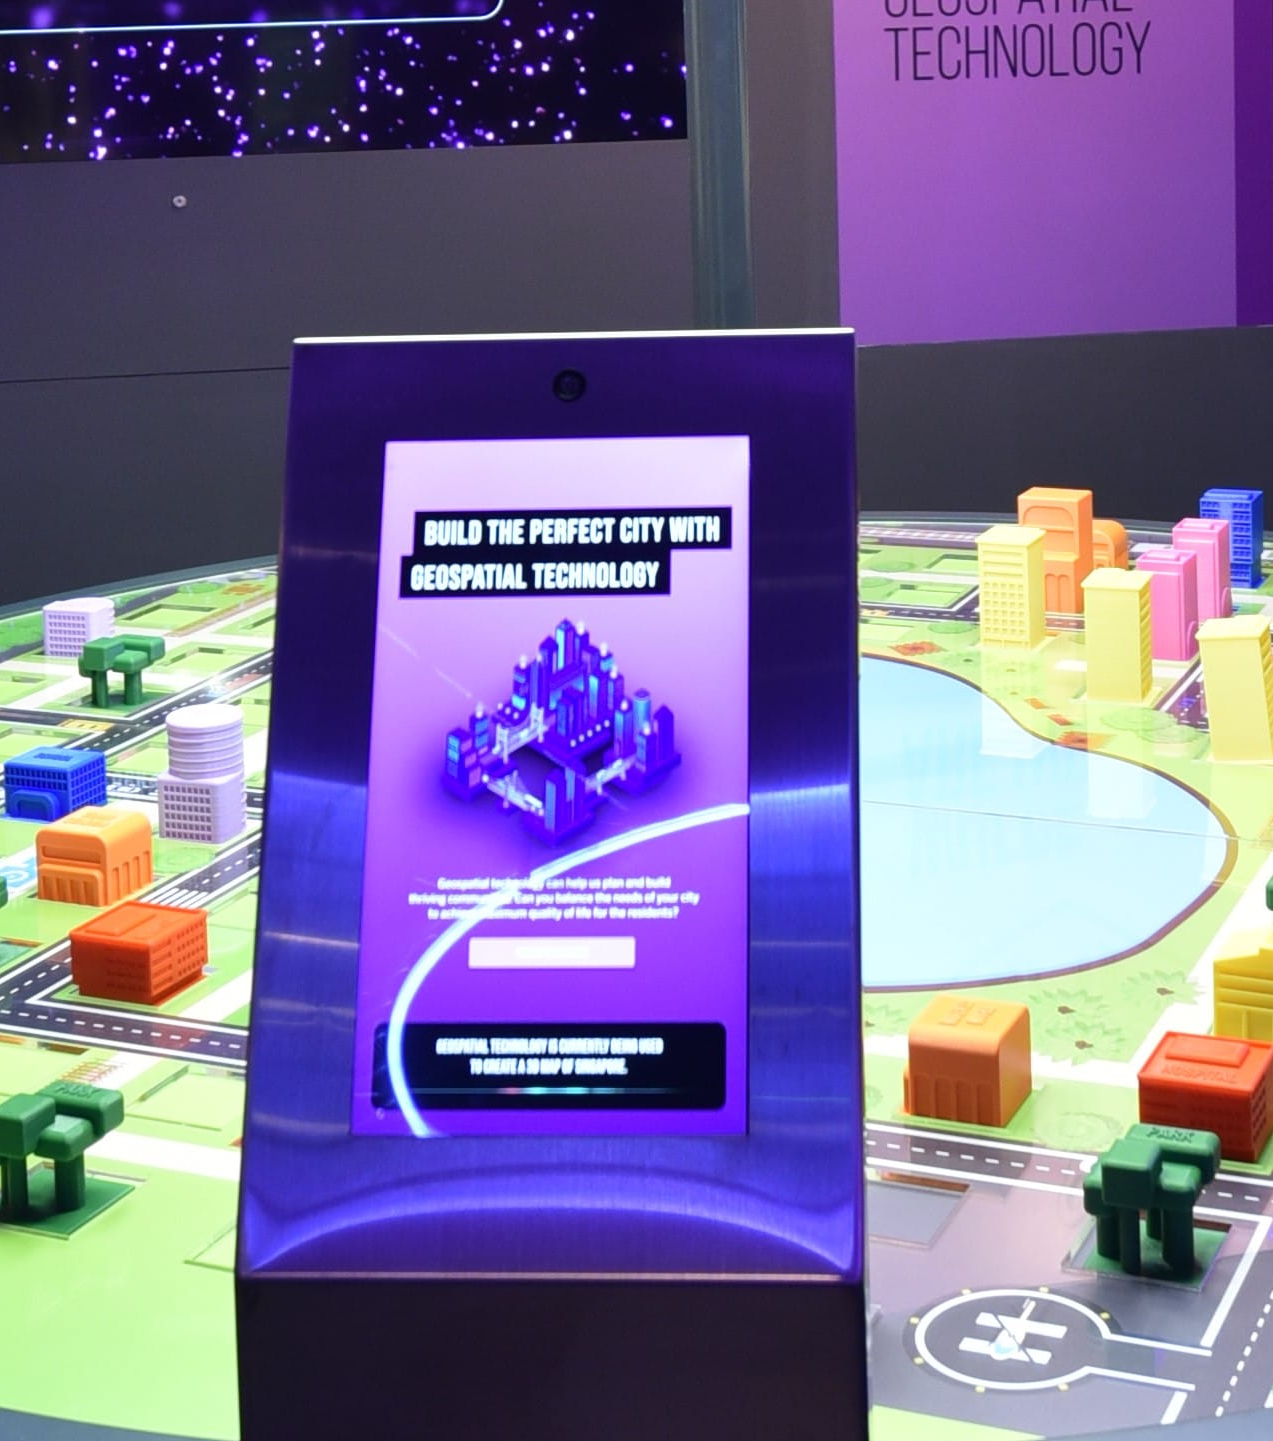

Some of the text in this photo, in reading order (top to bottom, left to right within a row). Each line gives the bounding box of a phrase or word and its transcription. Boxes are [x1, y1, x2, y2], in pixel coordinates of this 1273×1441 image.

[883, 20, 1151, 81] TECHNOLOGY
[424, 516, 720, 546] BUILD THE PERFECT CITY WITH
[411, 561, 659, 591] GEOSPATIAL TECHNOLOGY
